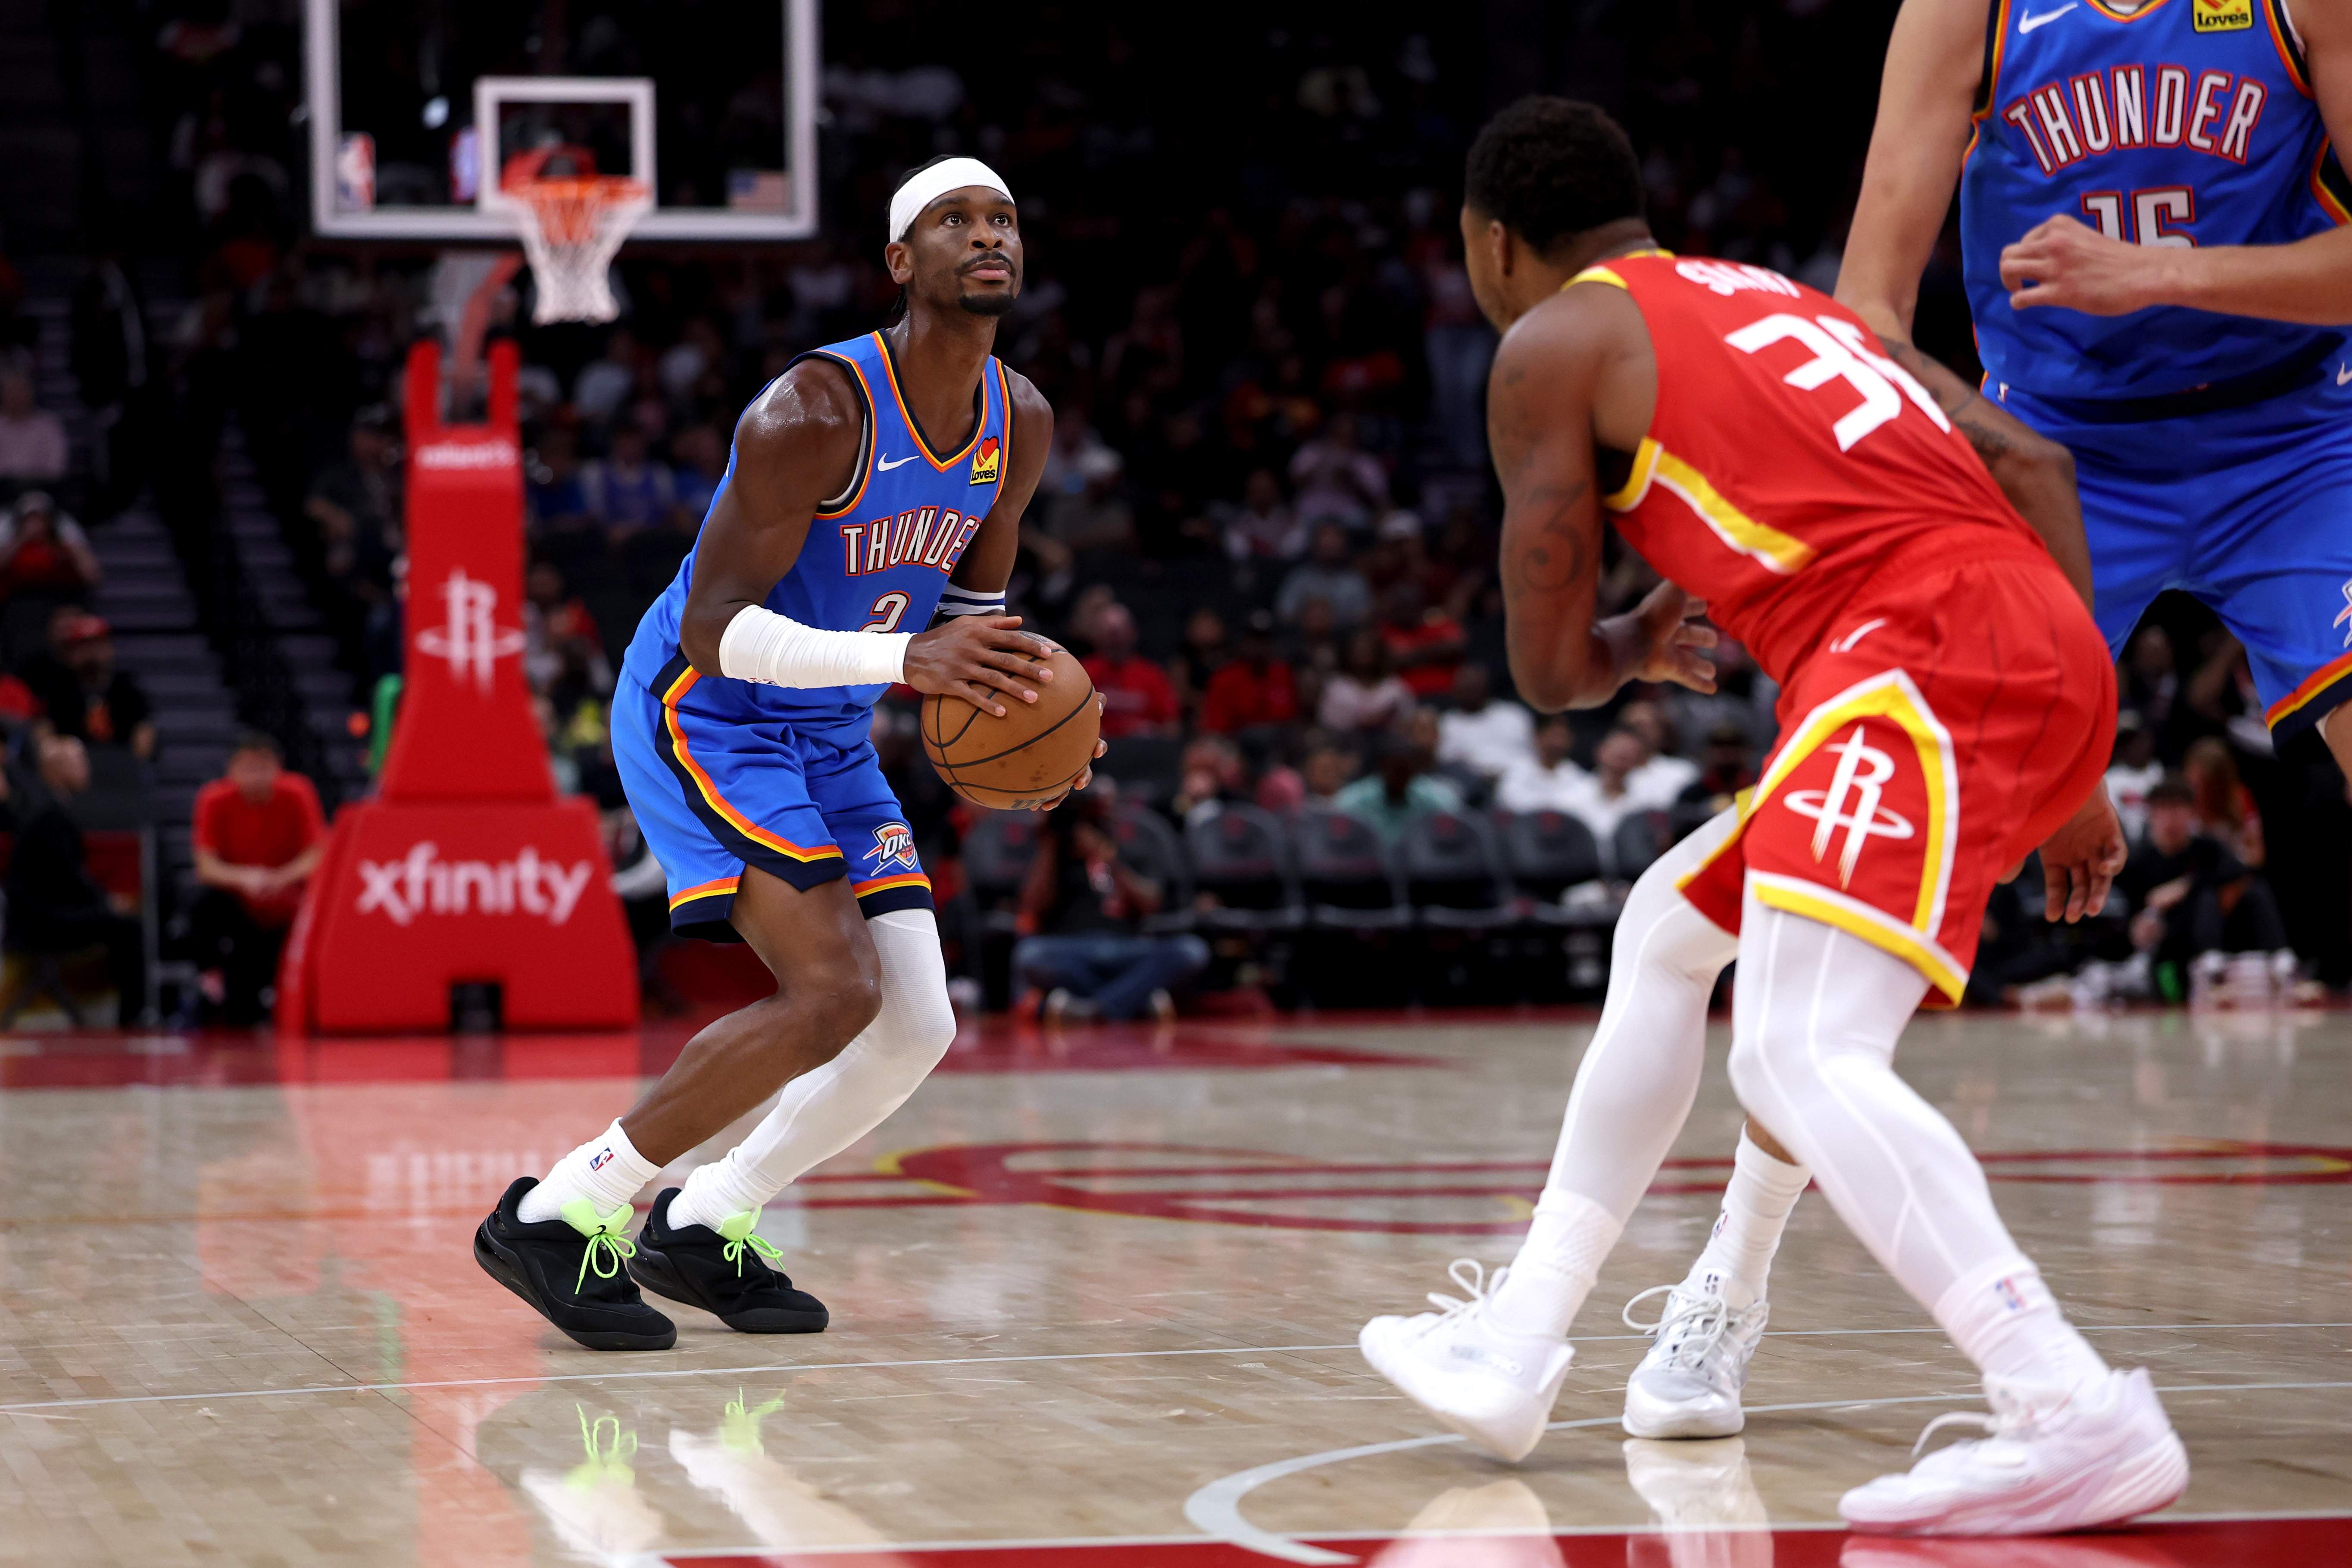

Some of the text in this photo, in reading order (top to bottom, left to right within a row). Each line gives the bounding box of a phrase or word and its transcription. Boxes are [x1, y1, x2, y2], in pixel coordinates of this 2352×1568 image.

[2002, 64, 2267, 177] THUNDER
[840, 506, 982, 576] THUNDE
[858, 590, 912, 634] 2
[882, 833, 912, 860] OKC
[356, 840, 592, 925] xfinity
